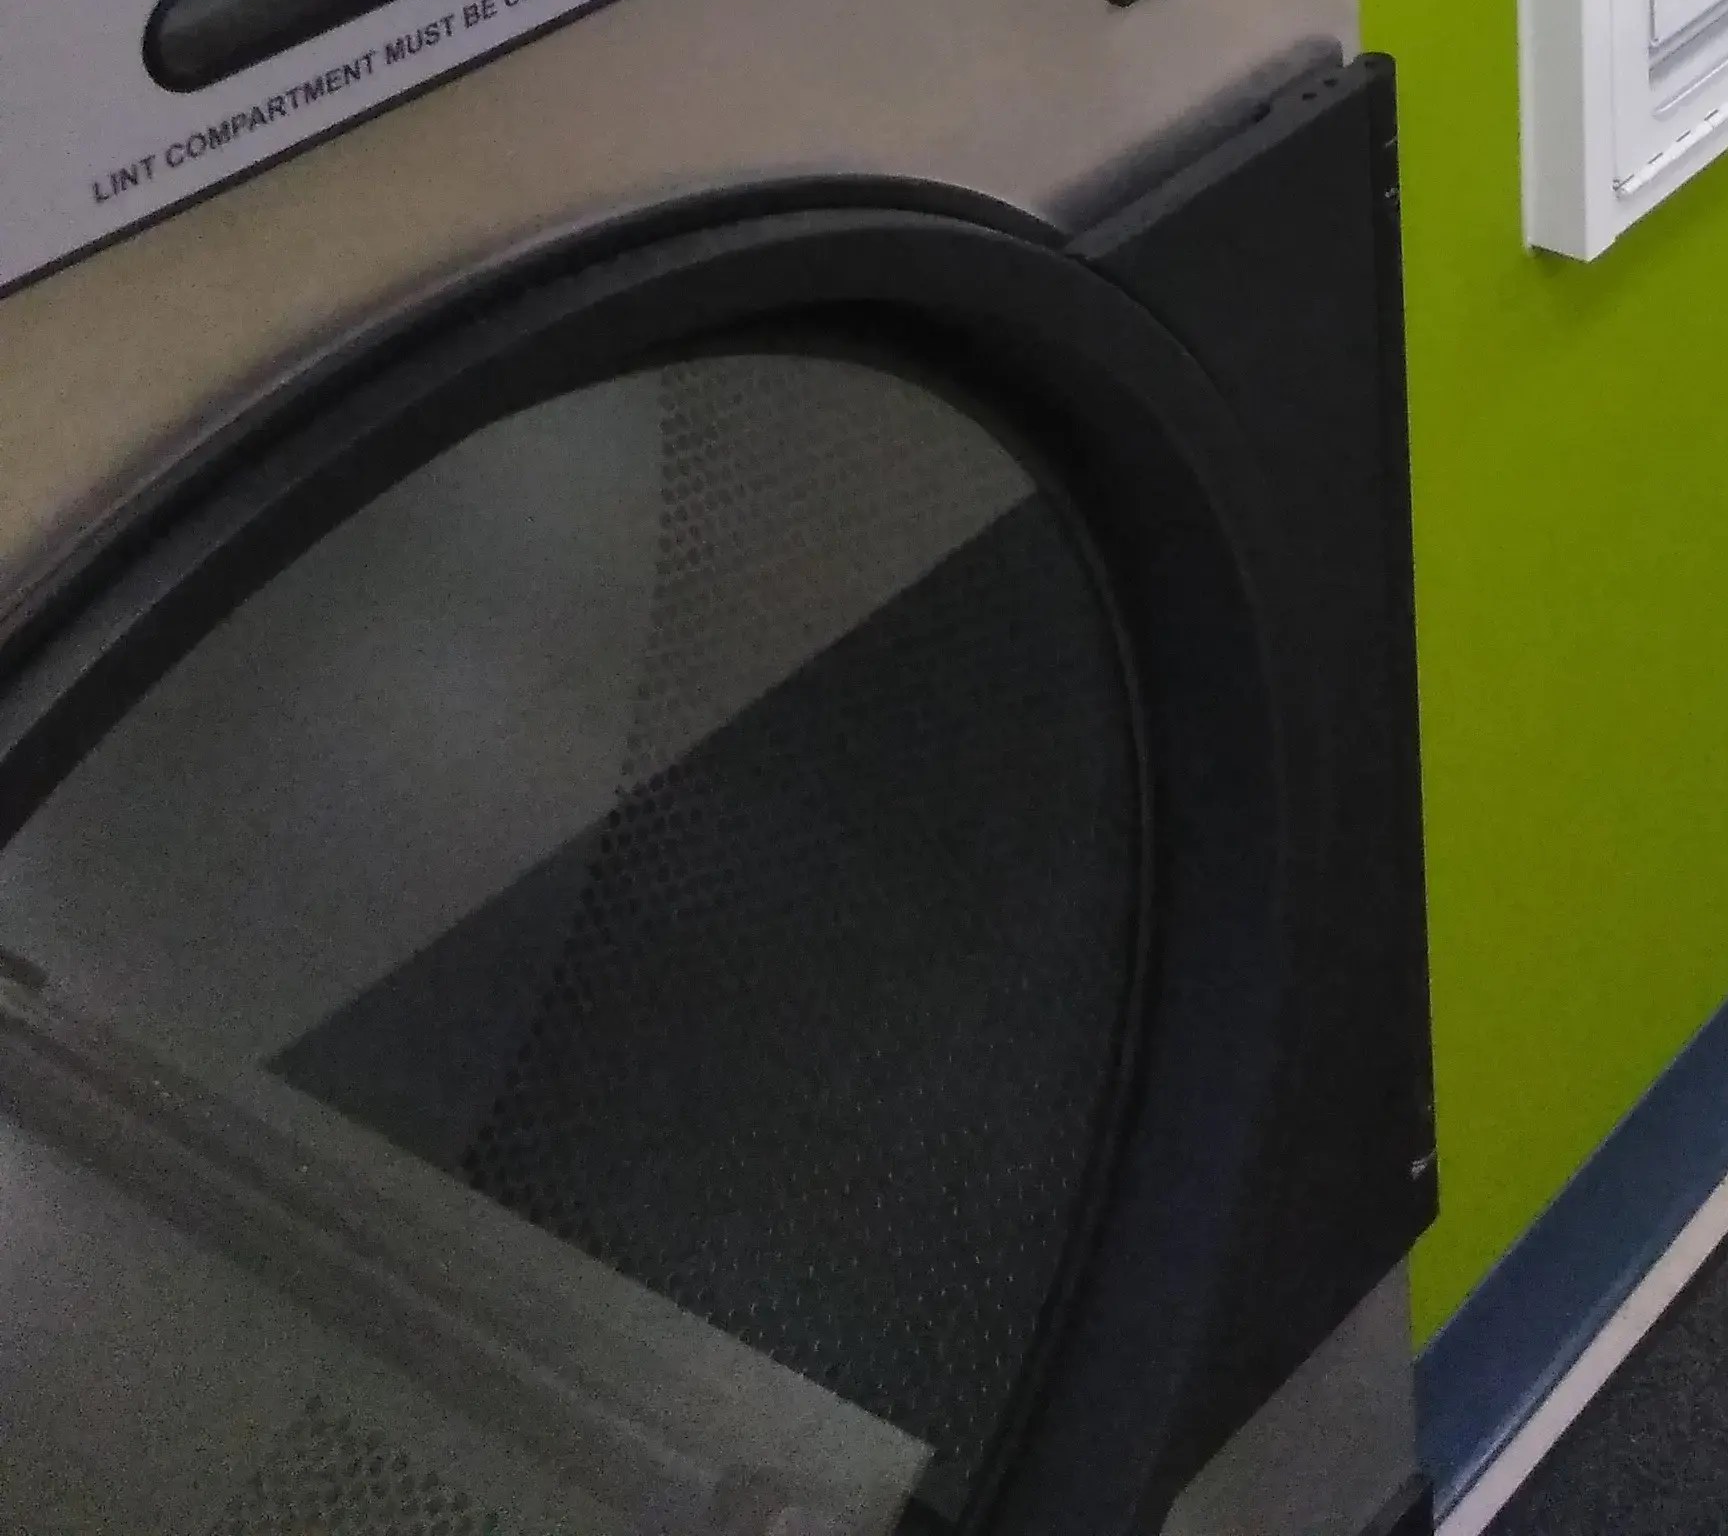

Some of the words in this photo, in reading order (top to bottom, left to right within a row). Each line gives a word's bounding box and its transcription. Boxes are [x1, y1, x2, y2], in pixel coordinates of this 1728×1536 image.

[92, 154, 155, 203] LINT
[165, 49, 378, 168] COMPARTMENT
[385, 14, 455, 65] MUST
